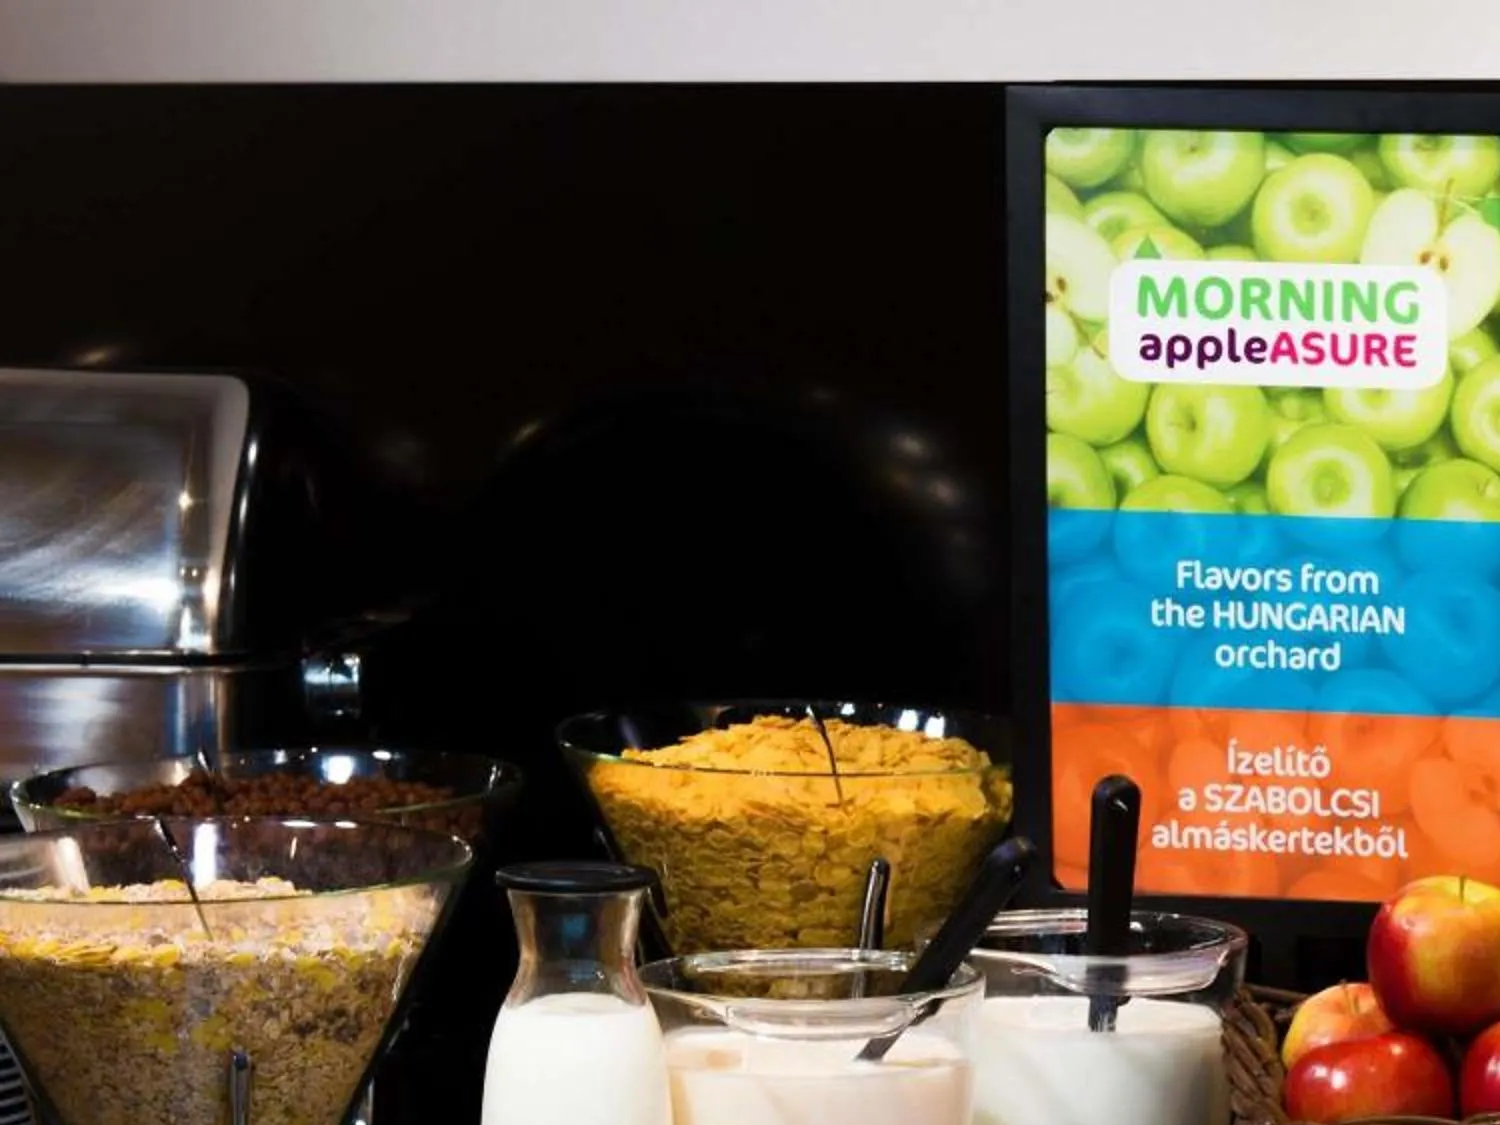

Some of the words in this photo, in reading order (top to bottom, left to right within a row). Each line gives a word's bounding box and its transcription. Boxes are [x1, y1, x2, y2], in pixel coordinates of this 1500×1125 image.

[1137, 276, 1420, 324] MORNING
[1139, 327, 1417, 371] appleASURE
[1175, 559, 1292, 594] Flavors
[1299, 562, 1379, 595] from
[1150, 596, 1205, 629] the
[1212, 602, 1405, 635] HUNGARIAN
[1214, 639, 1341, 671] orchard
[1227, 739, 1332, 779] Ízelítő
[1177, 789, 1197, 811] a
[1203, 784, 1380, 818] SZABOLCSI
[1151, 819, 1408, 859] almáskertekből
